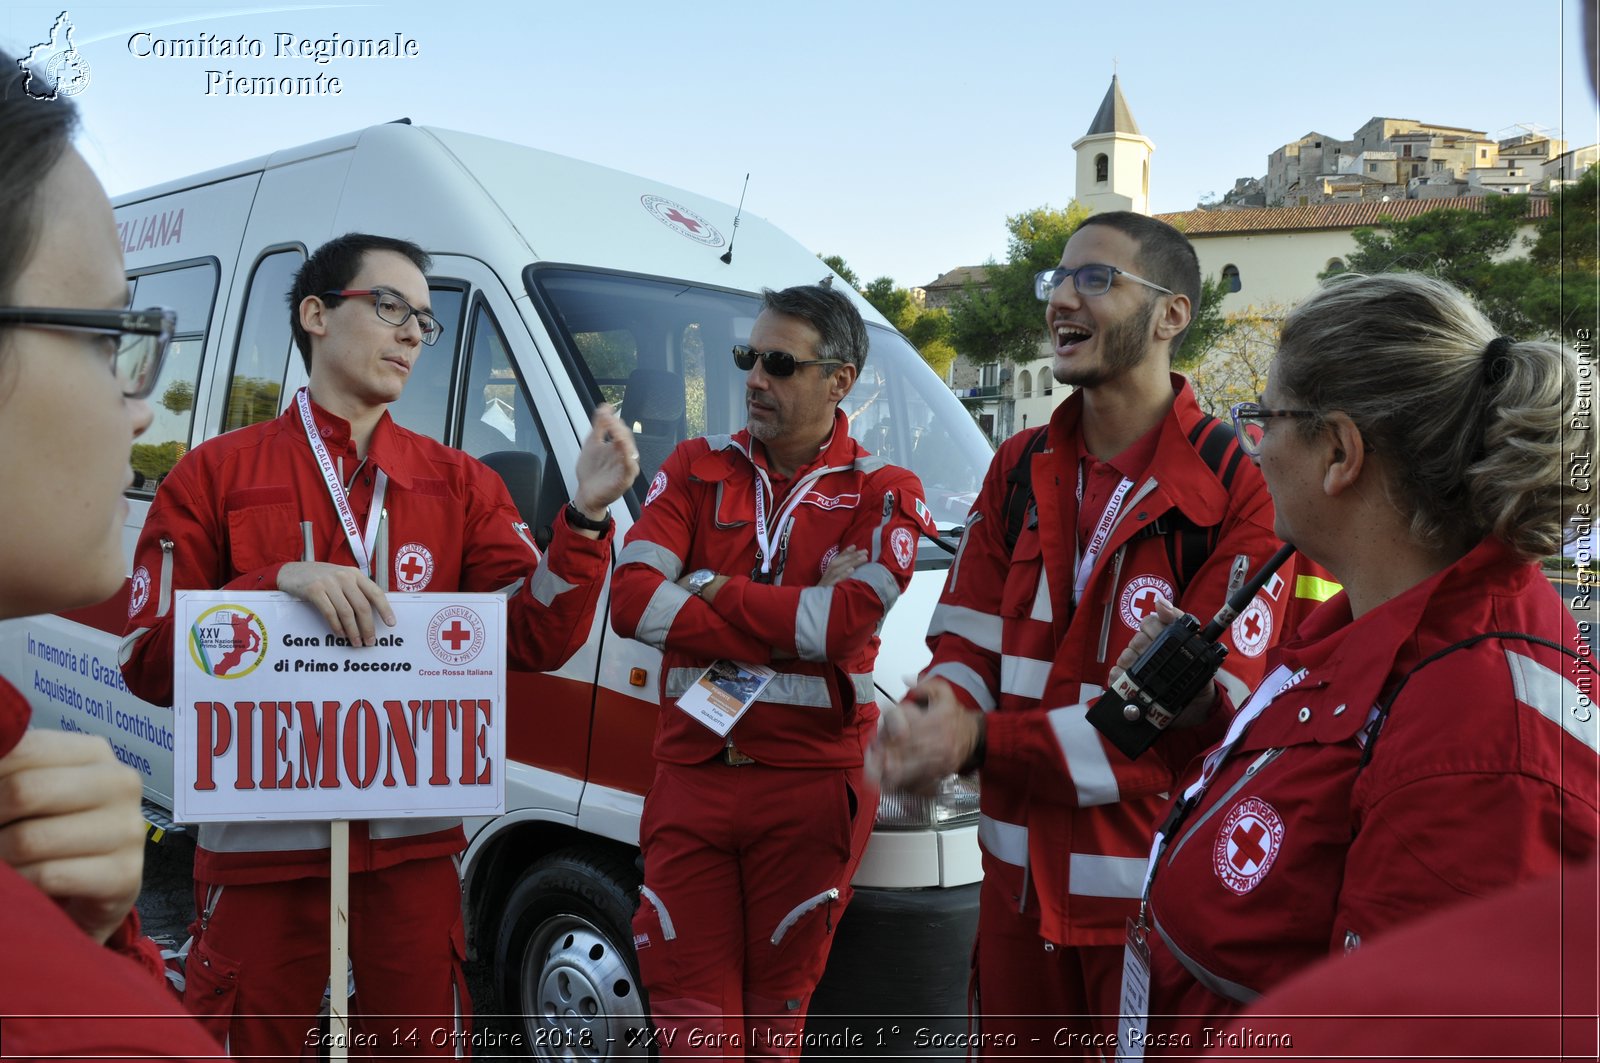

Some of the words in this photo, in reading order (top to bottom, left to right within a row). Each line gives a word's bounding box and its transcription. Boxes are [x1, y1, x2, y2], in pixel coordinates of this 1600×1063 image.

[115, 208, 185, 254] ALIANA
[301, 402, 317, 439] SOCCORSO
[314, 444, 332, 473] SCALEA
[327, 472, 336, 483] 13
[1118, 482, 1129, 494] 13
[331, 481, 349, 520] OTTOBRE
[1099, 494, 1121, 534] OTTOBRE
[344, 517, 358, 536] 2018
[757, 519, 765, 536] 2018
[1089, 534, 1105, 556] 2018
[199, 628, 220, 639] XXV
[281, 633, 319, 647] Gara
[429, 619, 452, 662] CONVENZIONE
[444, 607, 473, 621] GINEVRA
[471, 626, 483, 653] AGOSTO
[27, 632, 36, 654] In
[38, 642, 77, 672] memoria
[80, 653, 89, 677] di
[273, 658, 289, 673] di
[294, 658, 339, 673] Primo
[343, 658, 412, 673] Soccorso
[418, 668, 440, 676] Croce
[442, 668, 465, 676] Rossa
[466, 668, 493, 676] Italiana
[34, 670, 83, 710] Acquistato
[85, 694, 104, 721] con
[106, 700, 113, 724] il
[193, 699, 491, 791] PIEMONTE
[1217, 804, 1243, 872] CONVENZIONE
[1248, 799, 1279, 831] GINEVRA
